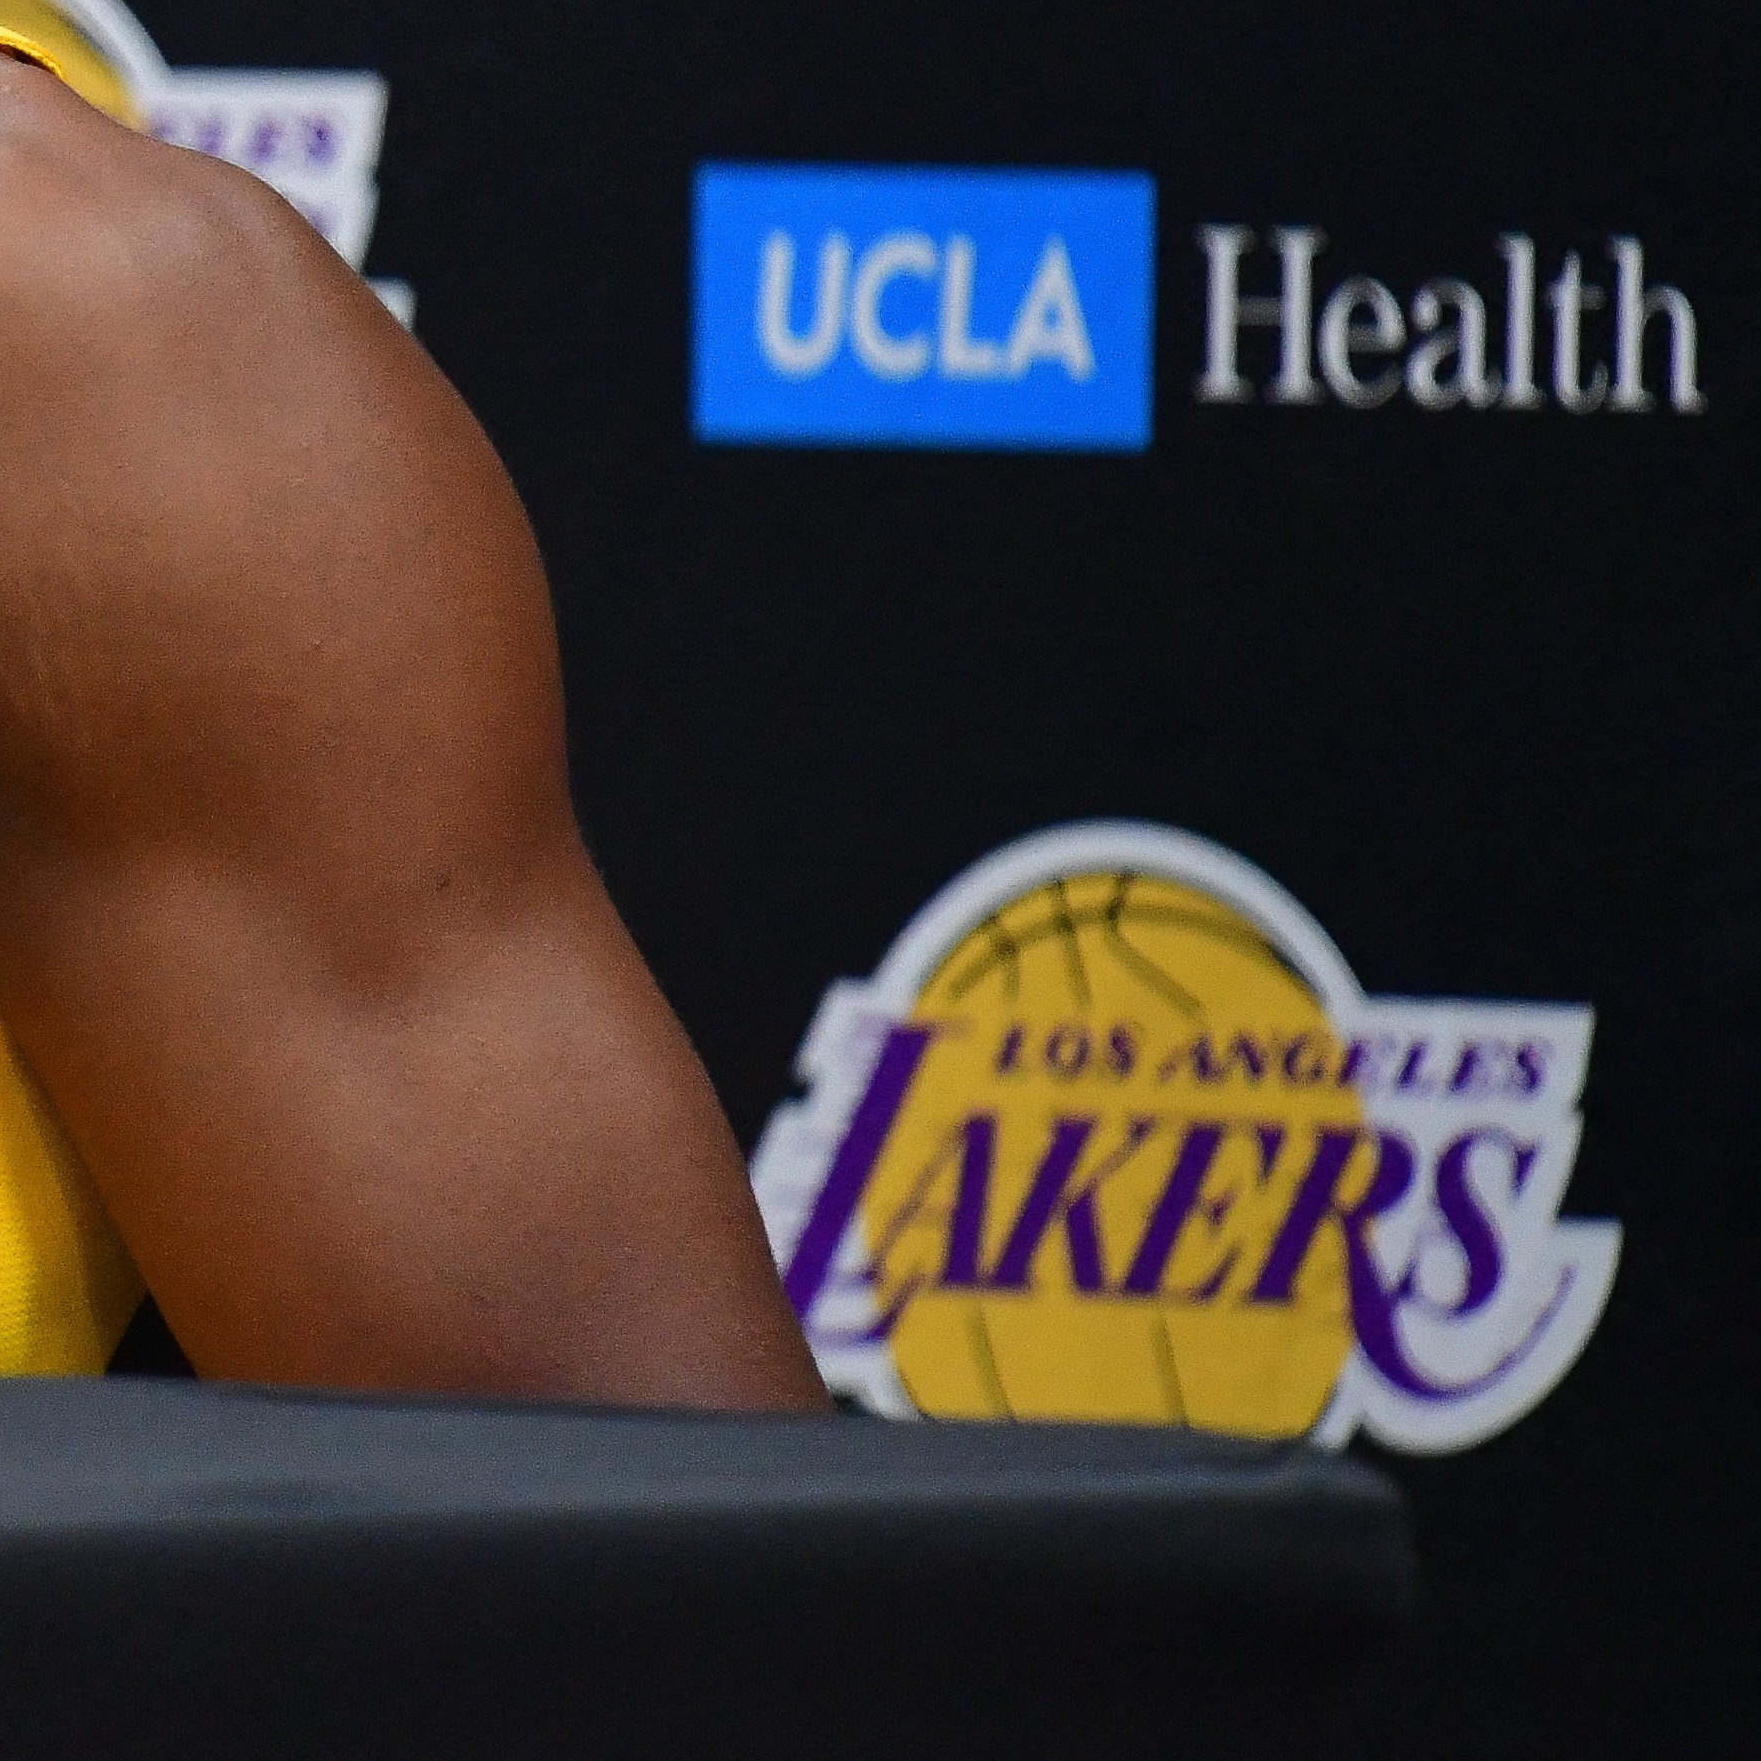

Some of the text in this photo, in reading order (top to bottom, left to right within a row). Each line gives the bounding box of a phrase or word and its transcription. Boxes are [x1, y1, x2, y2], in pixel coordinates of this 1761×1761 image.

[755, 222, 1709, 415] UCLA Health
[992, 1022, 1548, 1098] LOS ANGELES
[779, 1016, 1577, 1404] LAKERS
